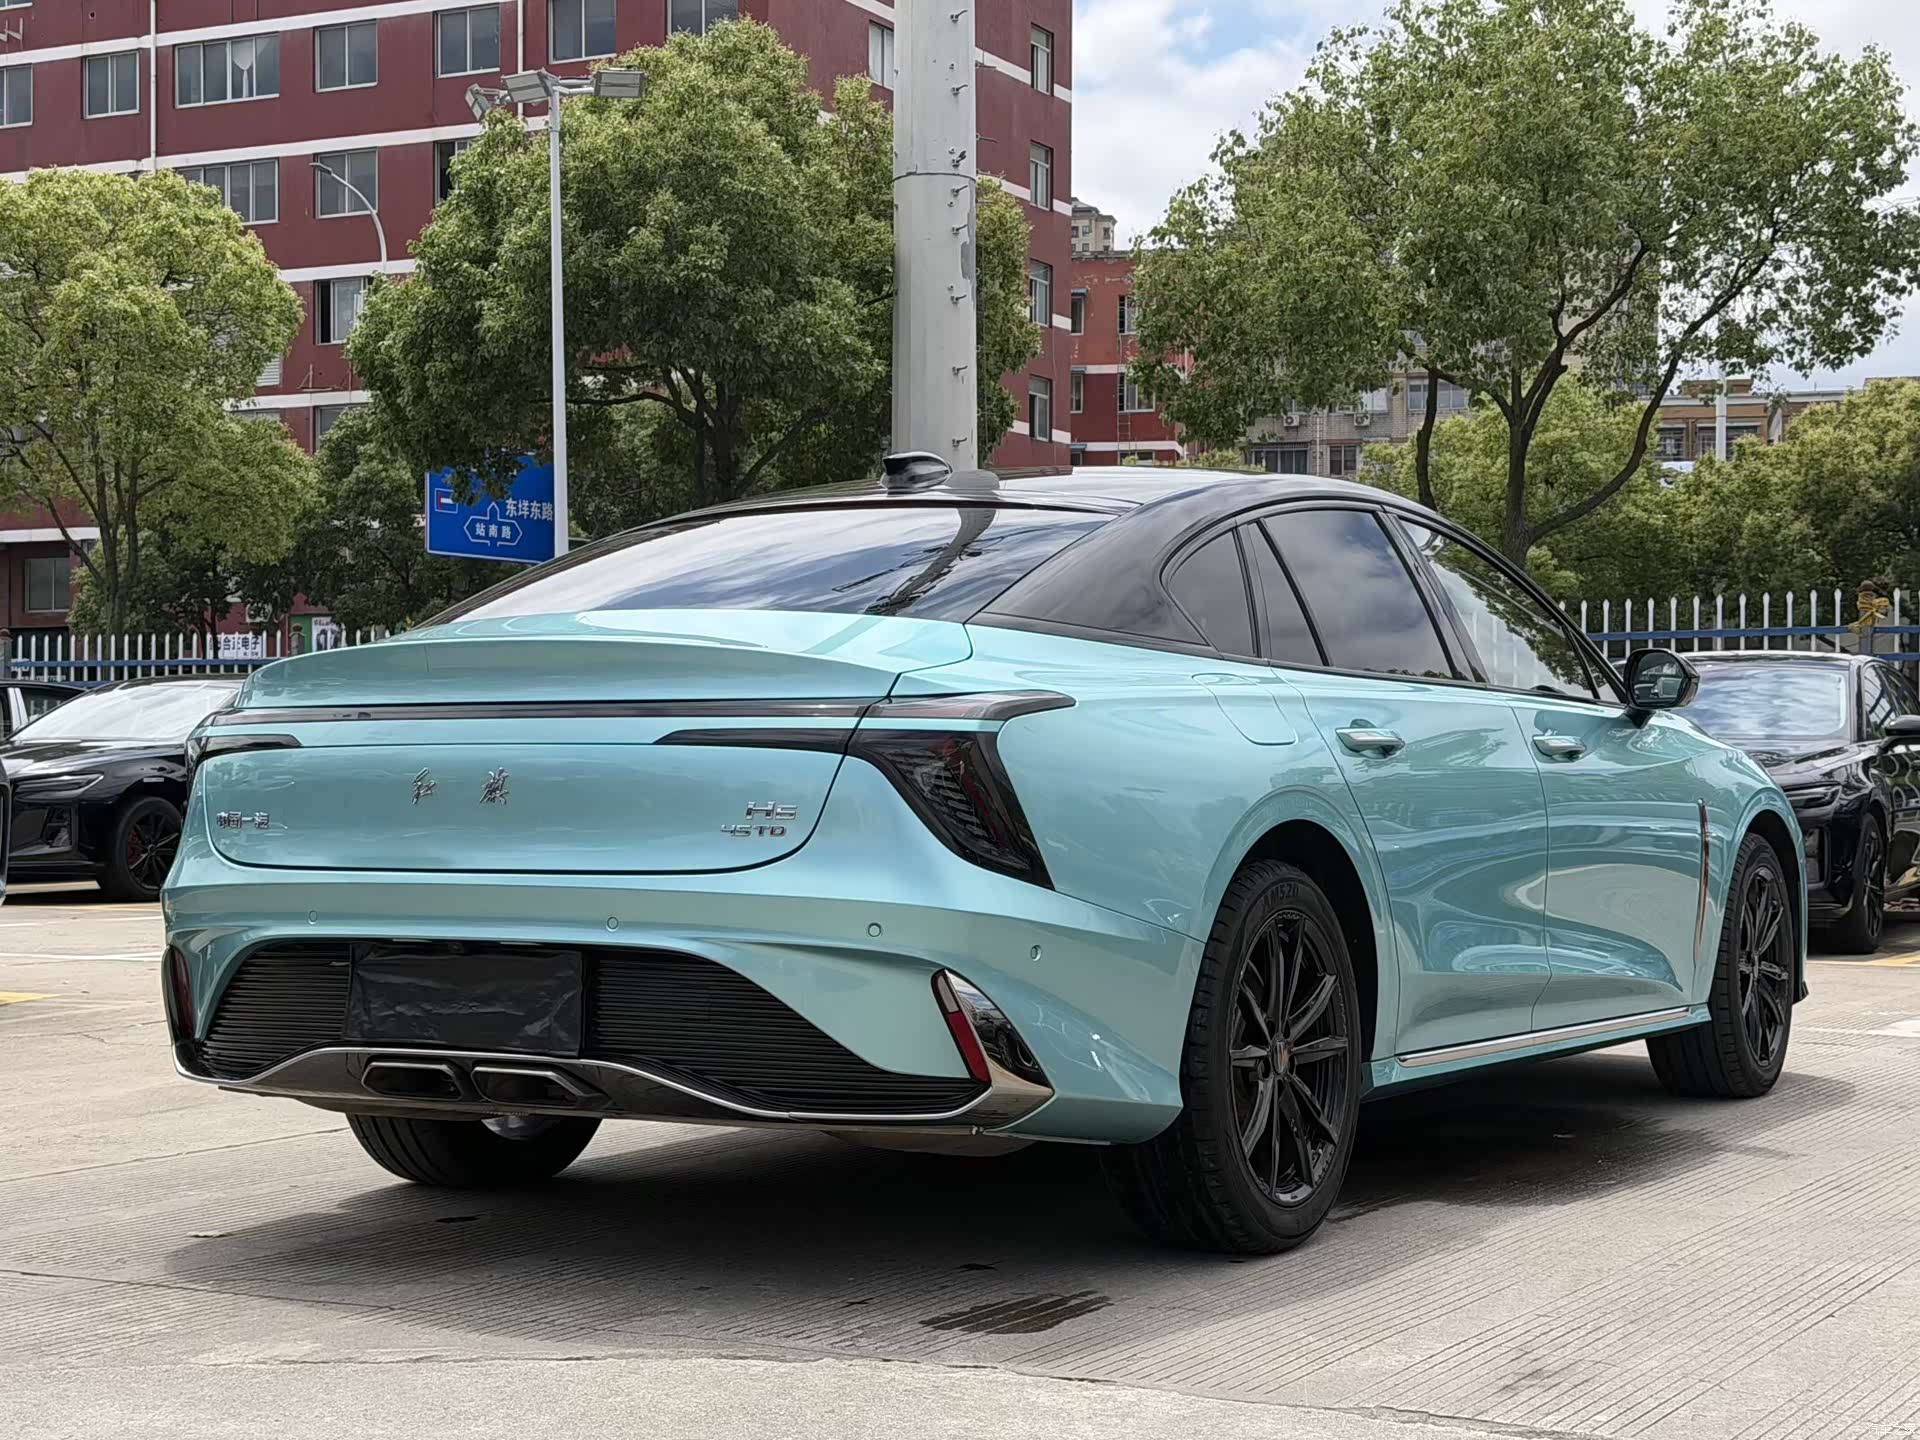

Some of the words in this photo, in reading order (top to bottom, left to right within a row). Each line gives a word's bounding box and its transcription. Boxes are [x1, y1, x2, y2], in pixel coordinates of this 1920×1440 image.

[506, 497, 553, 521] 东垟东路
[475, 522, 512, 539] 站南路
[216, 811, 271, 829] 中国一汽
